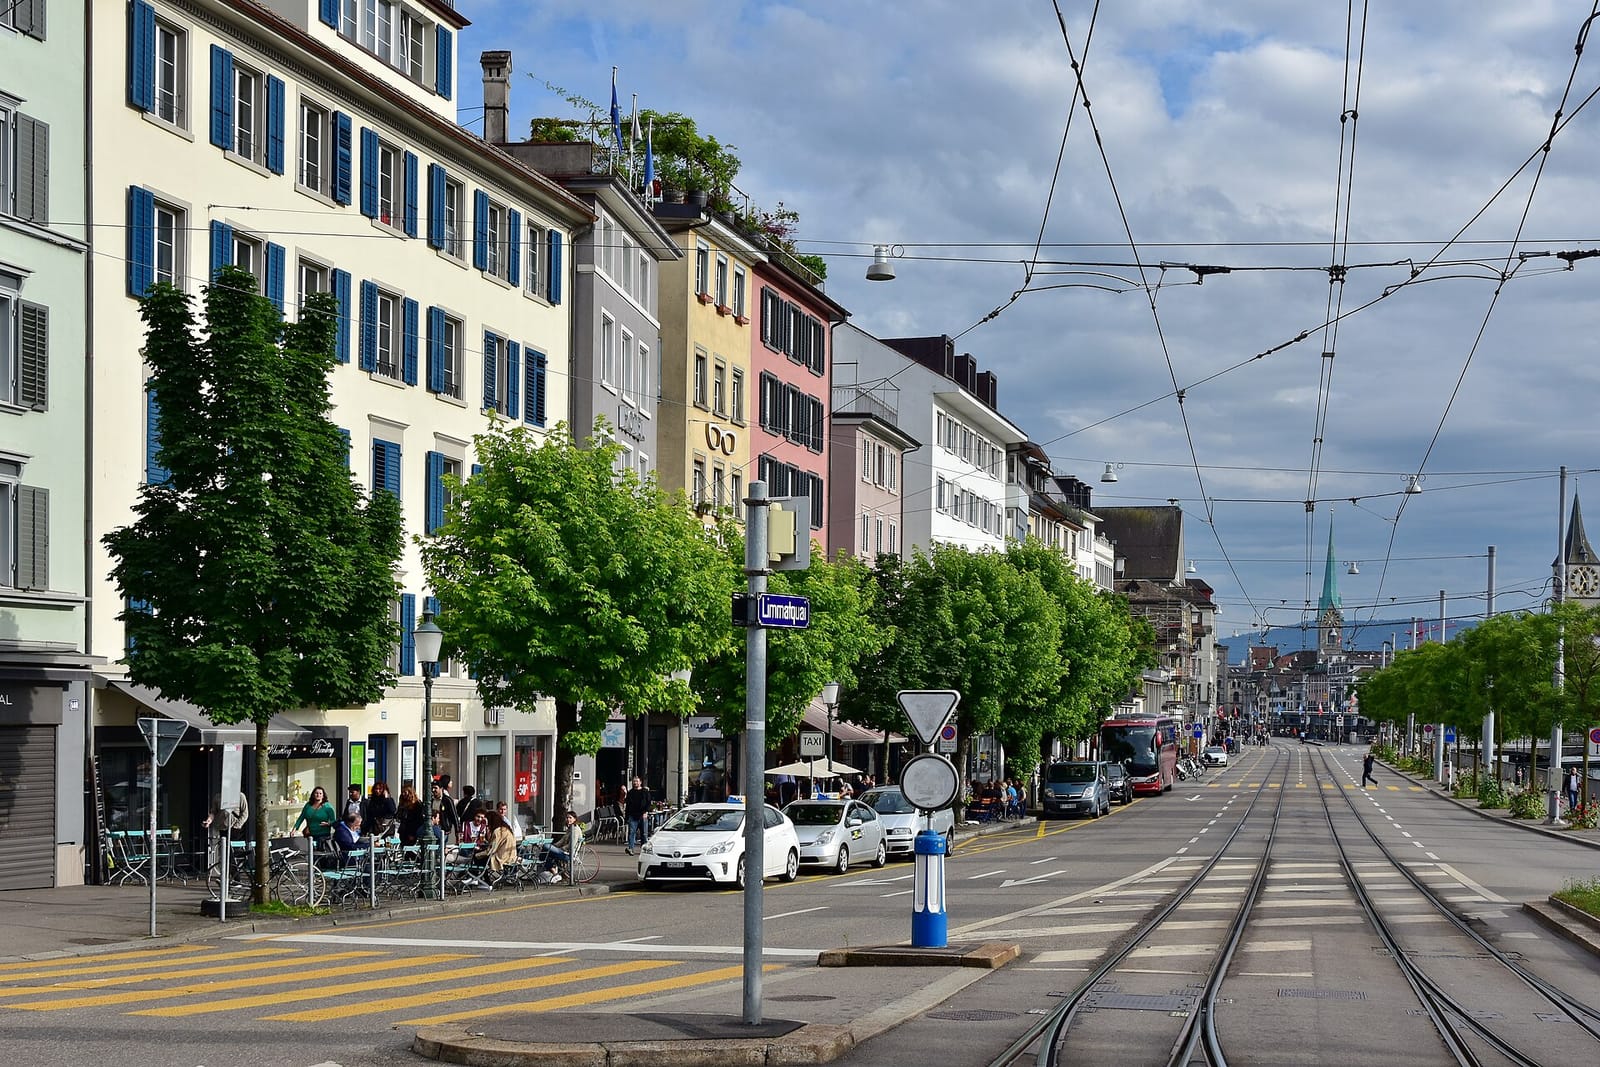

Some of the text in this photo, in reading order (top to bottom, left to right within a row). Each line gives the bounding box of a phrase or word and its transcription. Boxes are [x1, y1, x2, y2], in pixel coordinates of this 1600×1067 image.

[761, 596, 807, 626] Limmatquai
[433, 705, 455, 718] WE
[803, 737, 821, 746] TAXI
